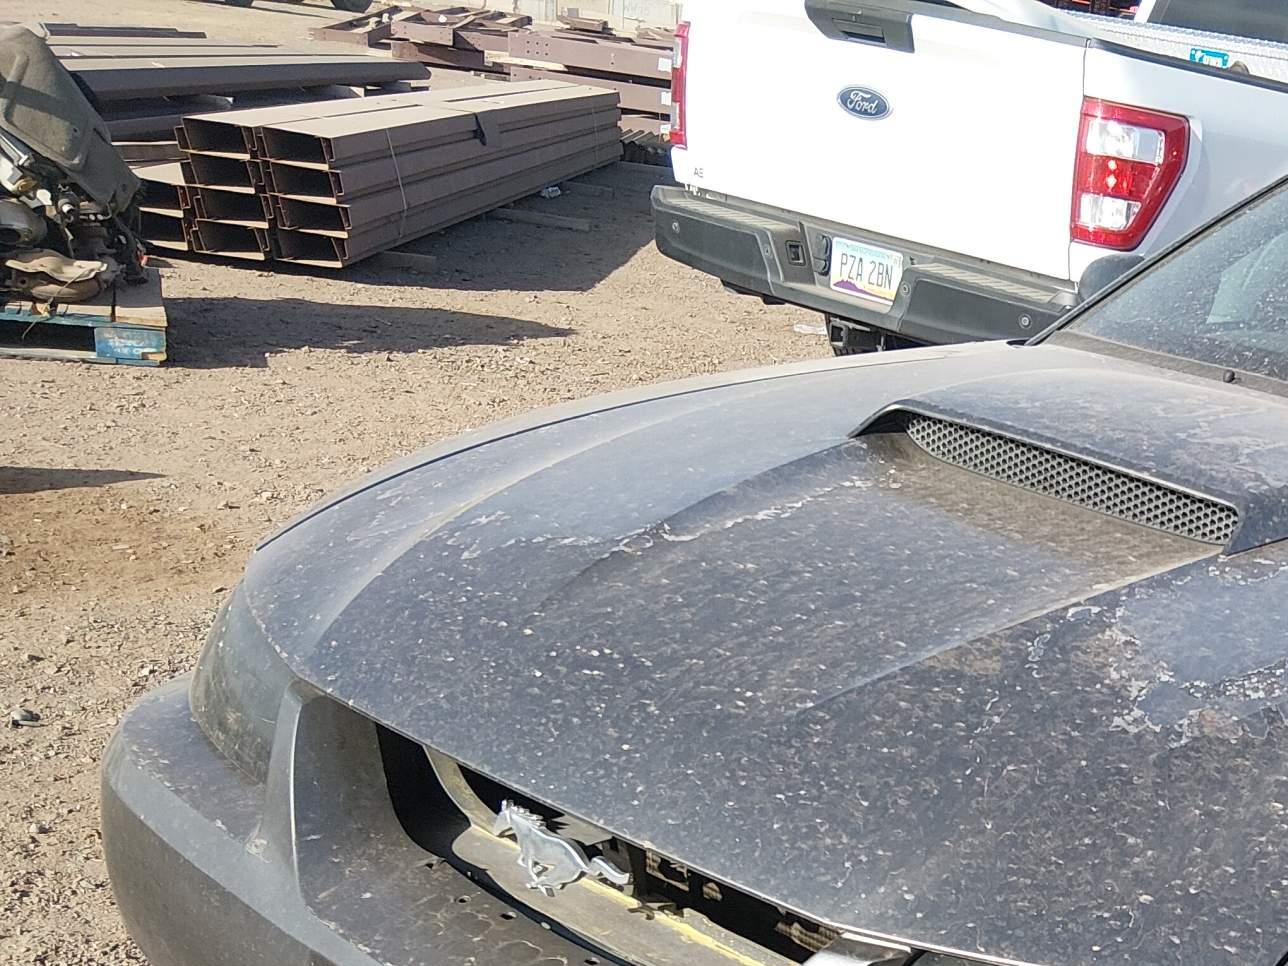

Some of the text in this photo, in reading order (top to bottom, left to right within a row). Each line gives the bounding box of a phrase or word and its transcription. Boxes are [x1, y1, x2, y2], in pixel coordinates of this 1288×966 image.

[847, 90, 878, 114] Ford
[839, 252, 865, 282] PZA
[867, 260, 894, 291] 2BN
